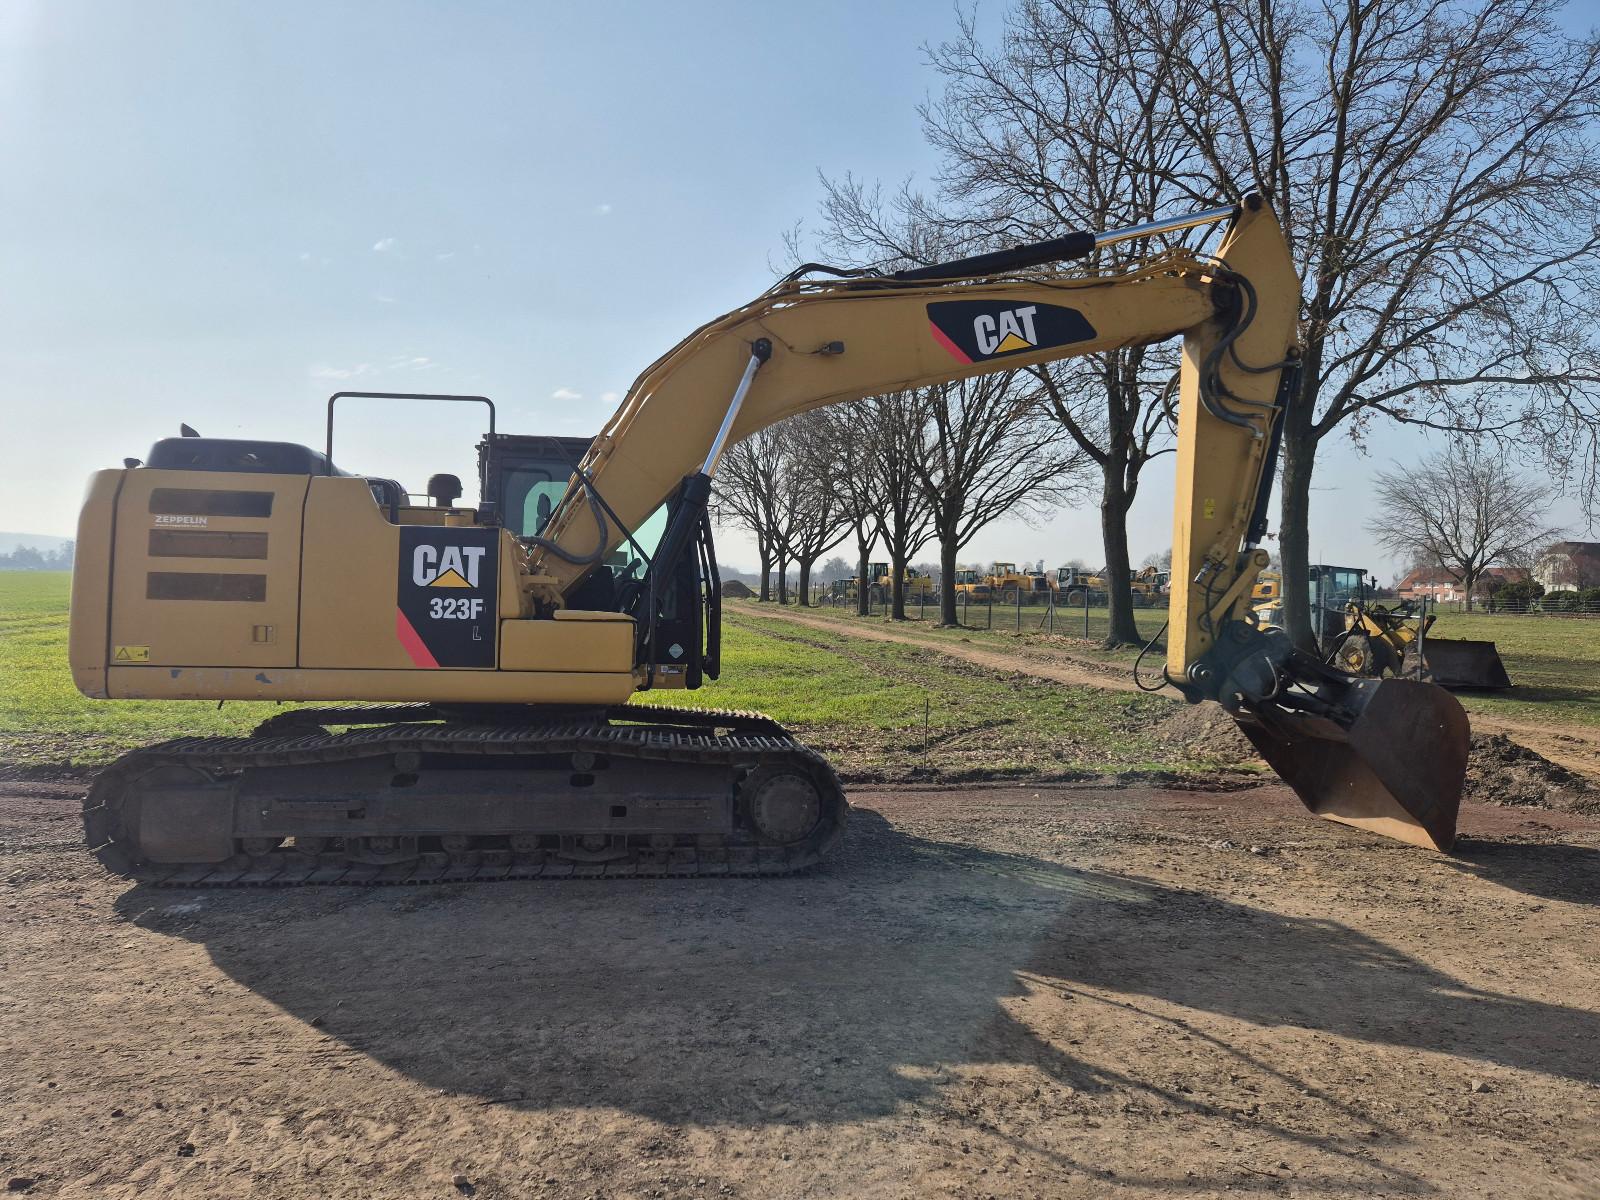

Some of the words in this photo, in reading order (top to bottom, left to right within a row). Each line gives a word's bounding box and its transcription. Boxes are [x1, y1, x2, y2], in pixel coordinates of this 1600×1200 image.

[973, 306, 1037, 355] CAT
[155, 515, 207, 524] ZEPPELIN
[413, 545, 486, 588] CAT
[429, 598, 484, 619] 323F
[472, 626, 482, 641] L
